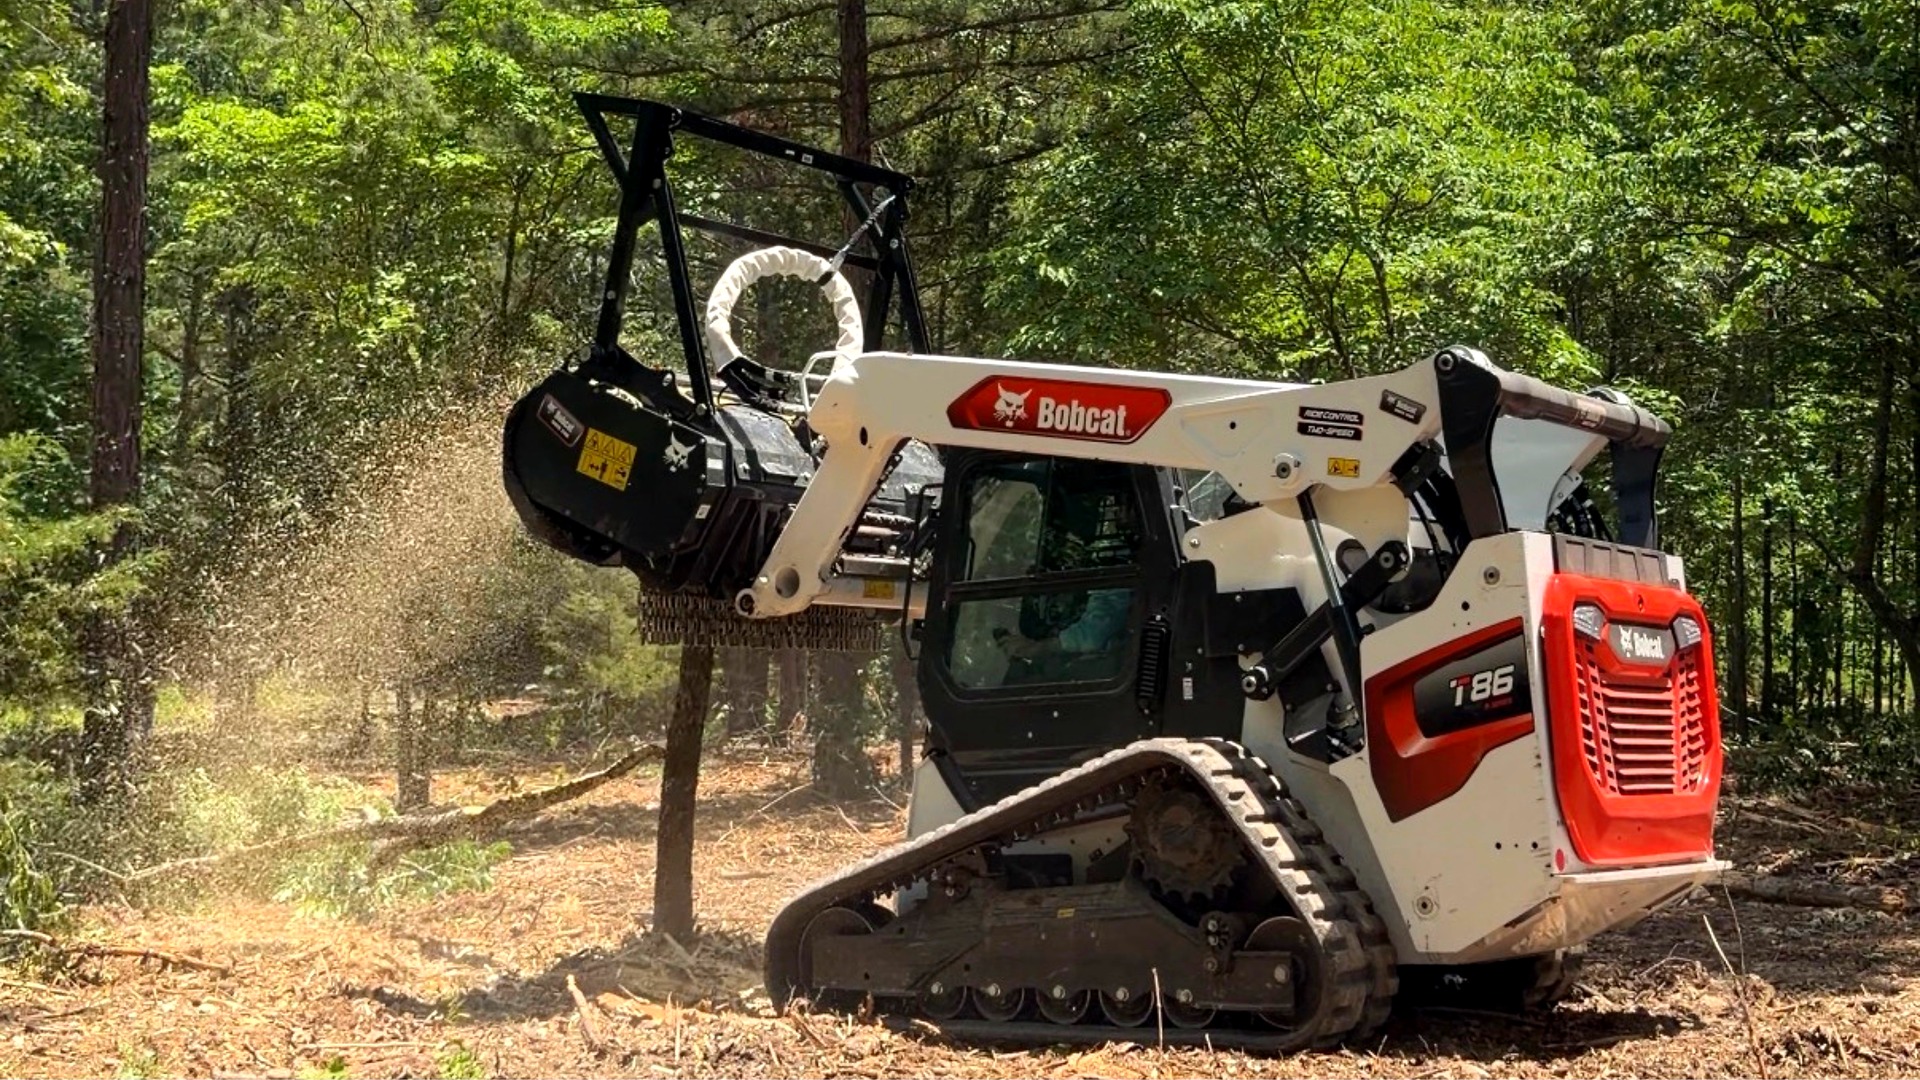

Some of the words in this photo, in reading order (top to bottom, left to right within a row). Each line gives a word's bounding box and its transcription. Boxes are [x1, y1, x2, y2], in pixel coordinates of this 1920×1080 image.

[1037, 396, 1127, 436] Bobcat
[1322, 411, 1360, 422] CONTROL
[1307, 425, 1355, 438] TWO-SPEED
[1633, 632, 1665, 659] Bobcat
[1449, 664, 1515, 707] T86
